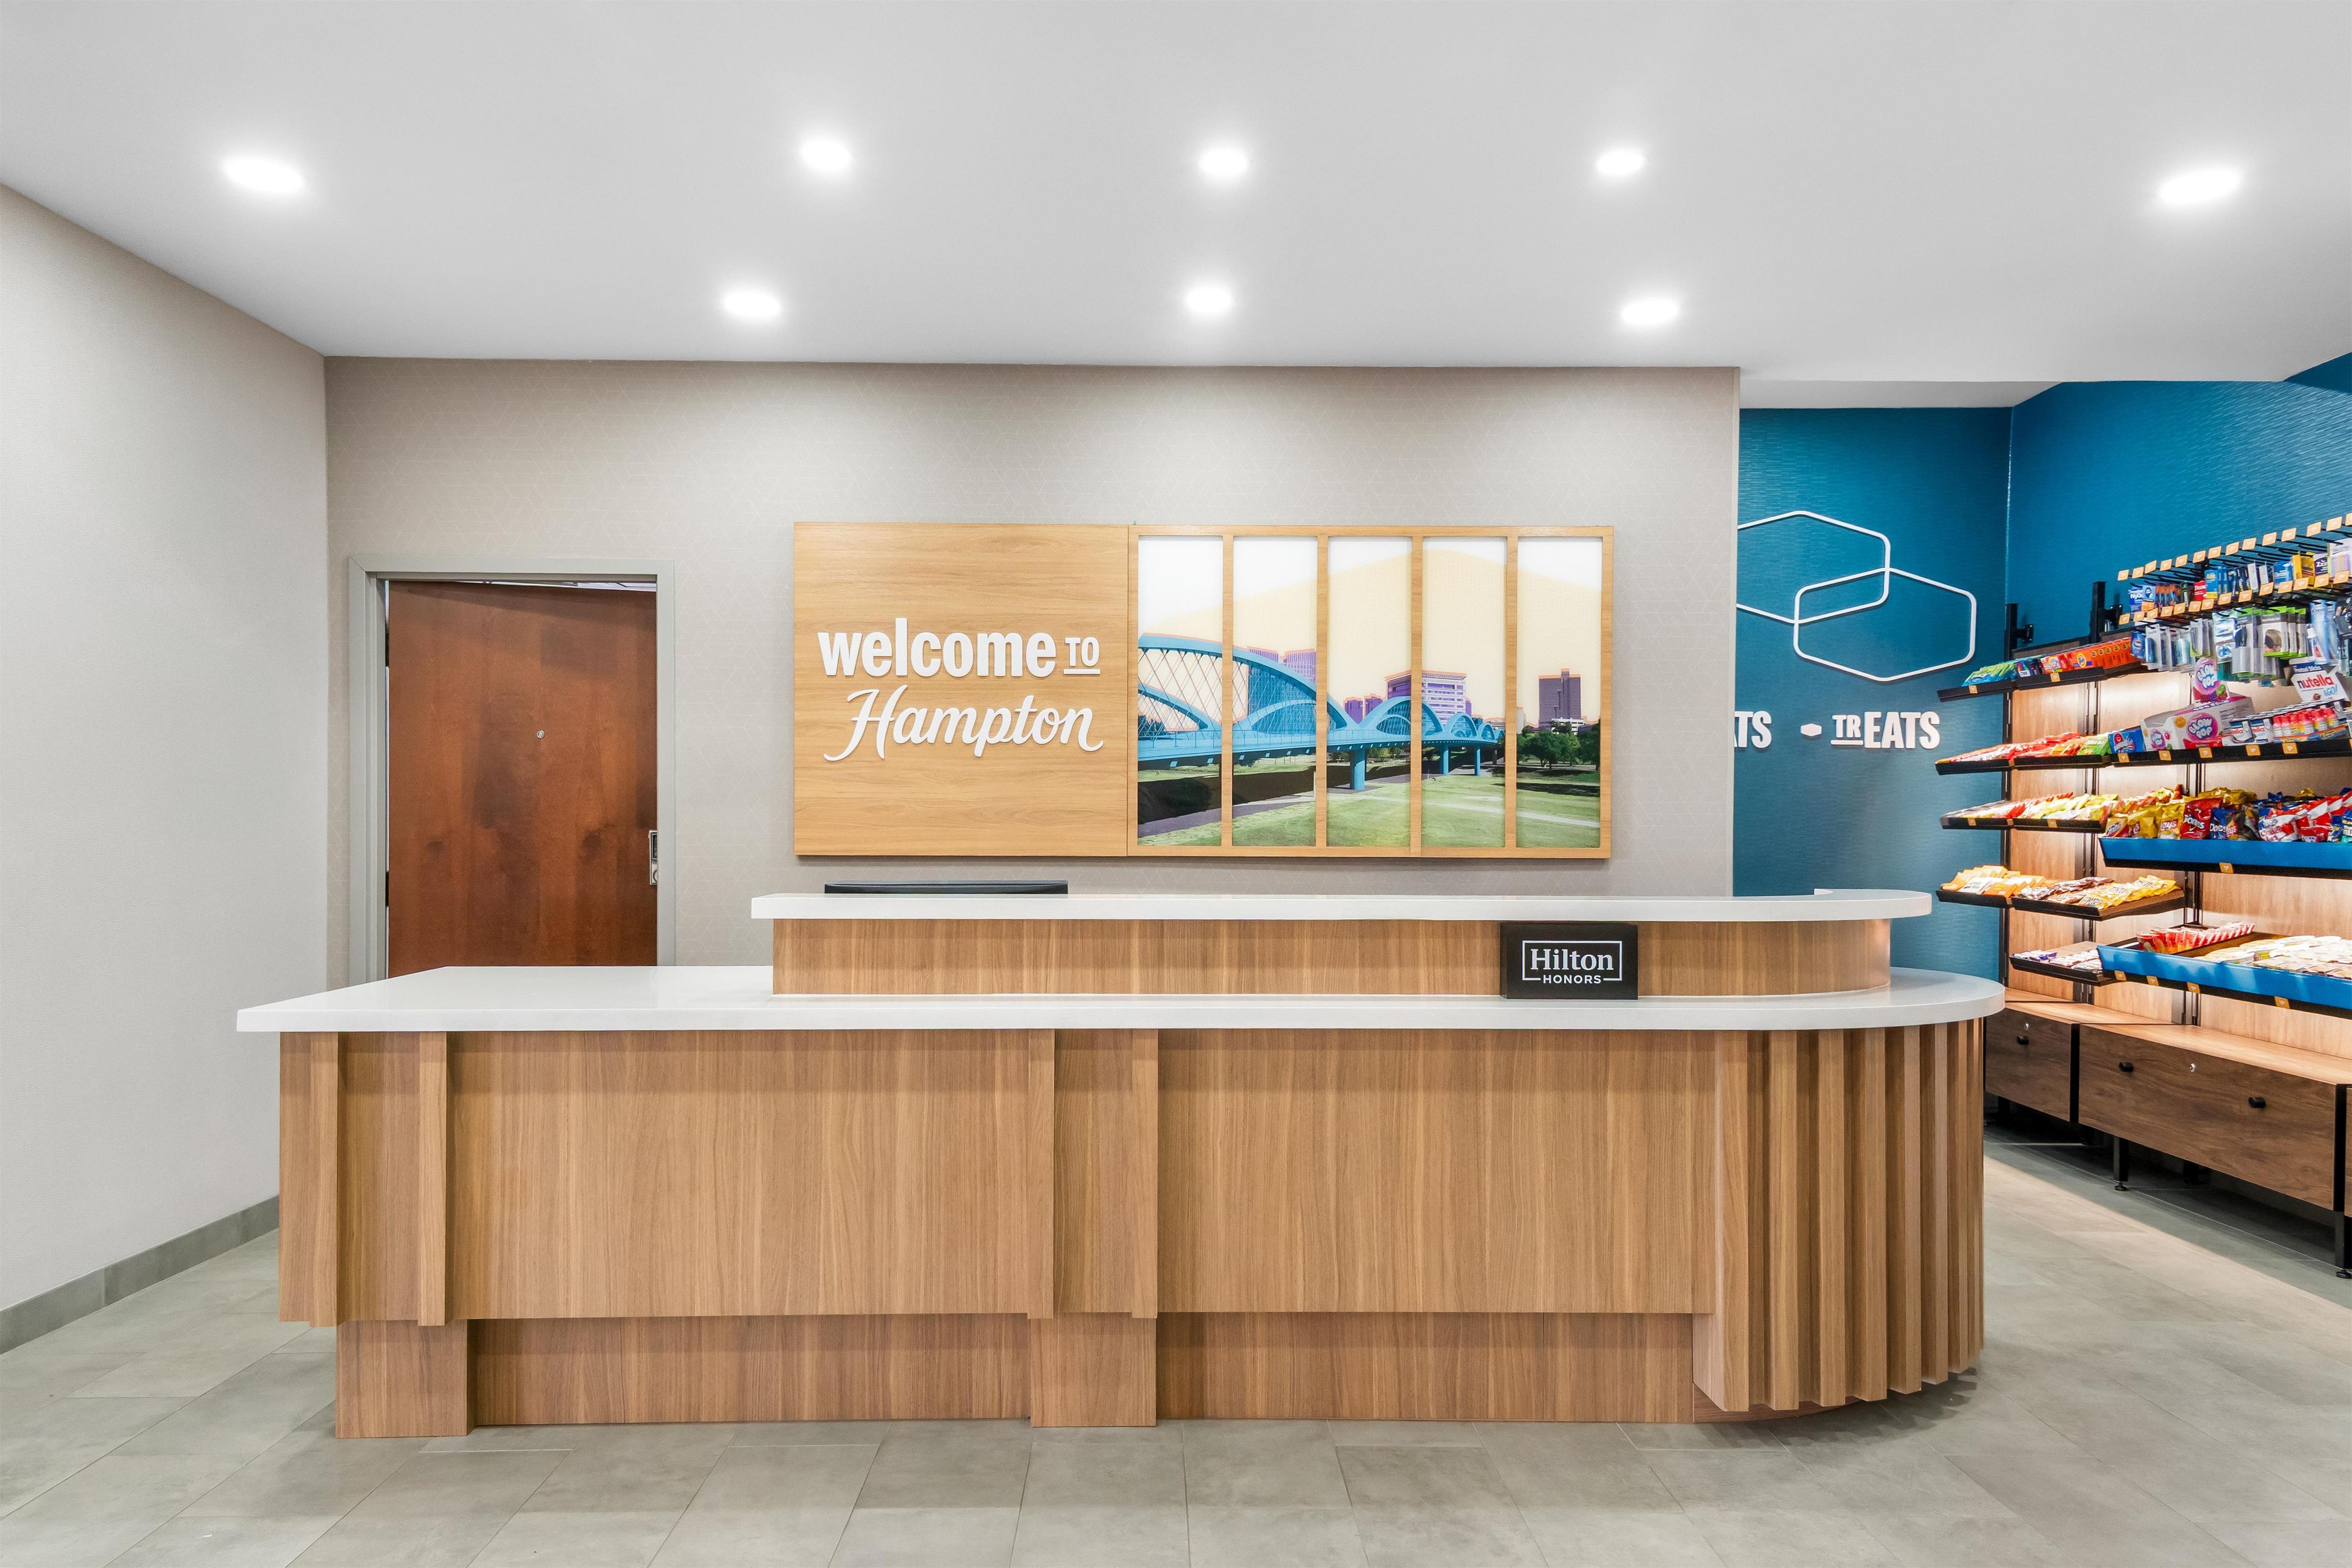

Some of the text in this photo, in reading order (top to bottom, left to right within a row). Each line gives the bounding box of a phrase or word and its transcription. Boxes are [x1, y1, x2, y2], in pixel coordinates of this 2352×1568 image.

[818, 617, 1101, 677] welcome TO
[2297, 674, 2334, 689] nutella
[823, 684, 1104, 761] Hampton
[1830, 711, 1940, 749] TREATS
[2188, 717, 2212, 734] BLOW
[2196, 726, 2213, 739] POP
[1531, 949, 1614, 970] Hilton
[1543, 974, 1602, 984] HONORS
